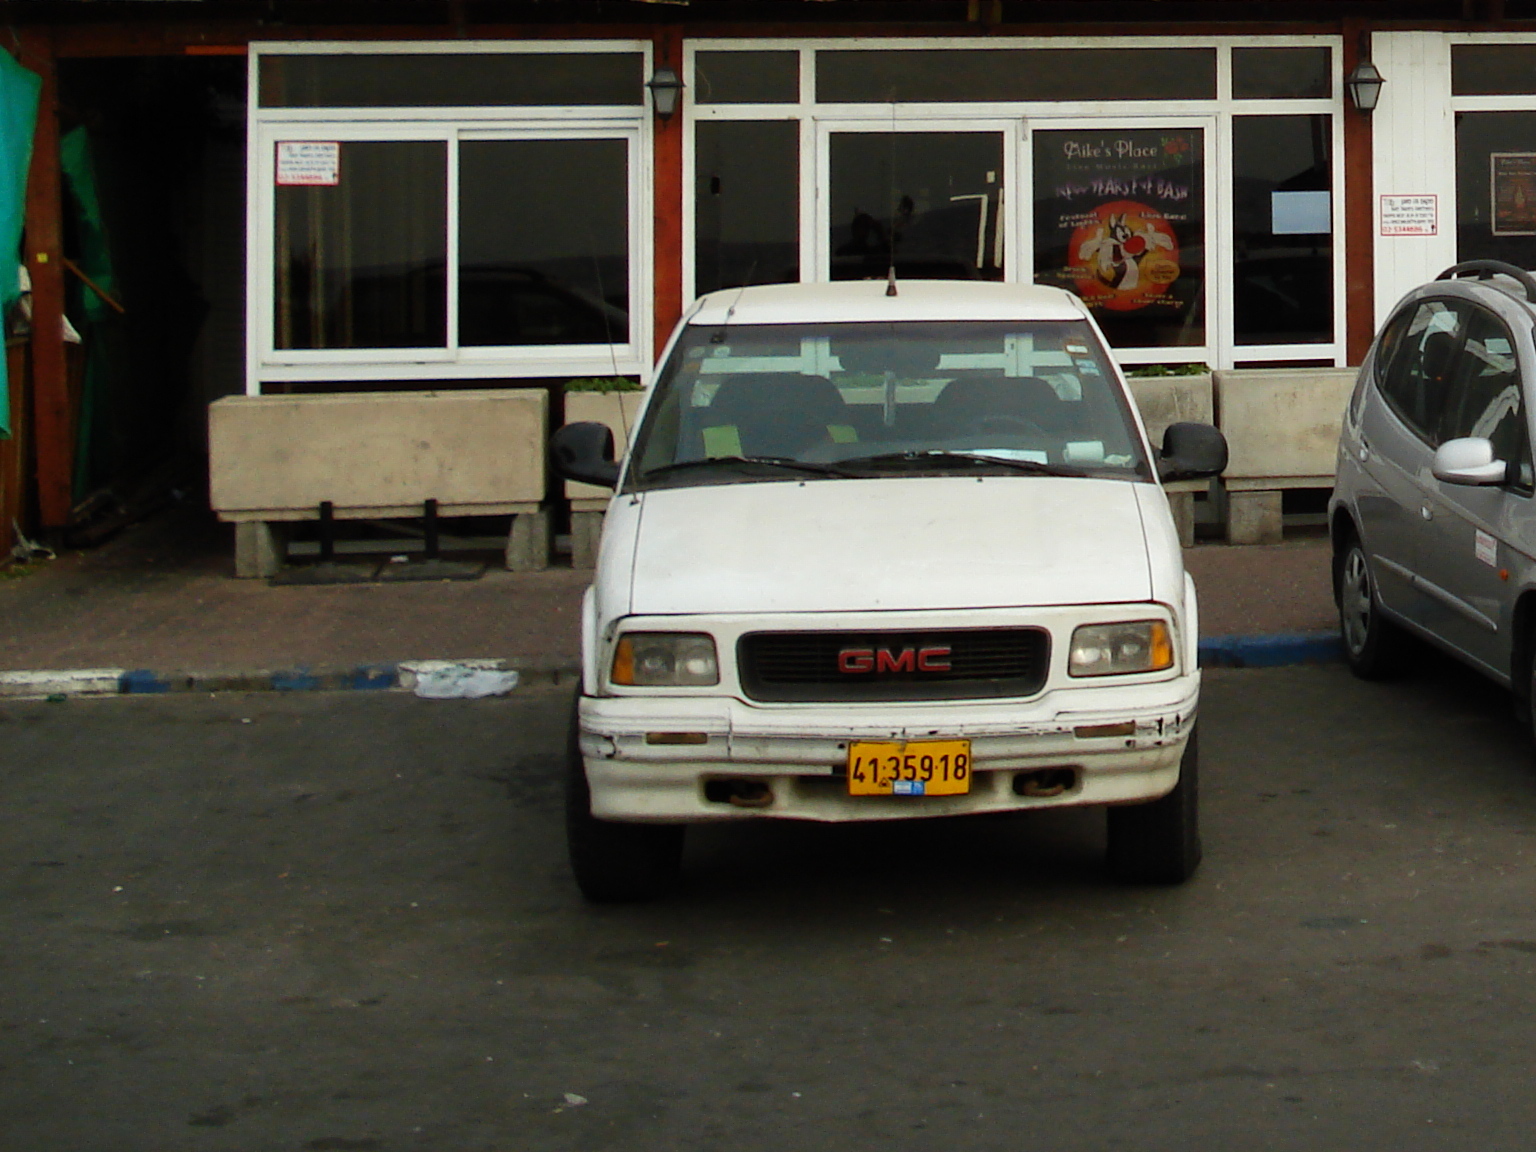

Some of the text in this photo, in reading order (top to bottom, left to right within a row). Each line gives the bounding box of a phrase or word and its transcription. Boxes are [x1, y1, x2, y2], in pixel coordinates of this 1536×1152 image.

[1063, 139, 1158, 160] Mike's Place
[838, 647, 952, 673] GMC
